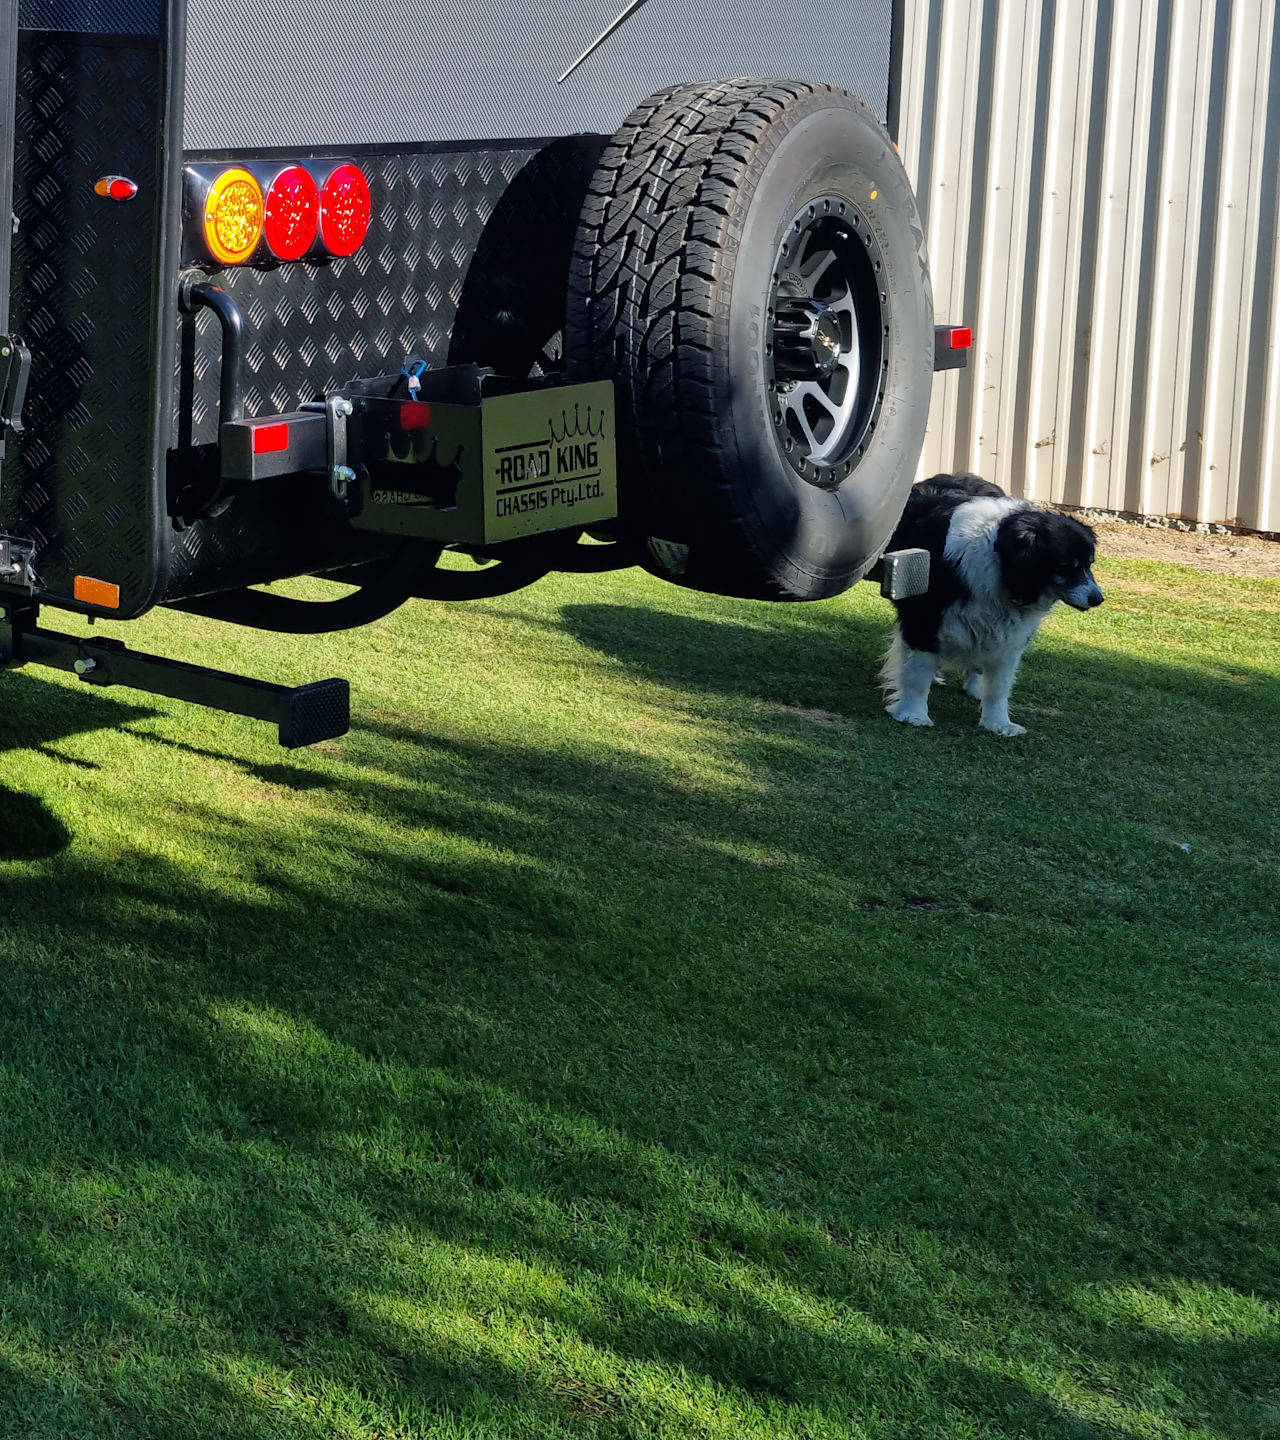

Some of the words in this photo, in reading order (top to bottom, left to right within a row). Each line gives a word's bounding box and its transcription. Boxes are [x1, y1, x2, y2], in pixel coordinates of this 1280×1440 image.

[500, 450, 550, 484] ROAD
[557, 442, 598, 473] KING
[496, 491, 547, 517] CHASSIS
